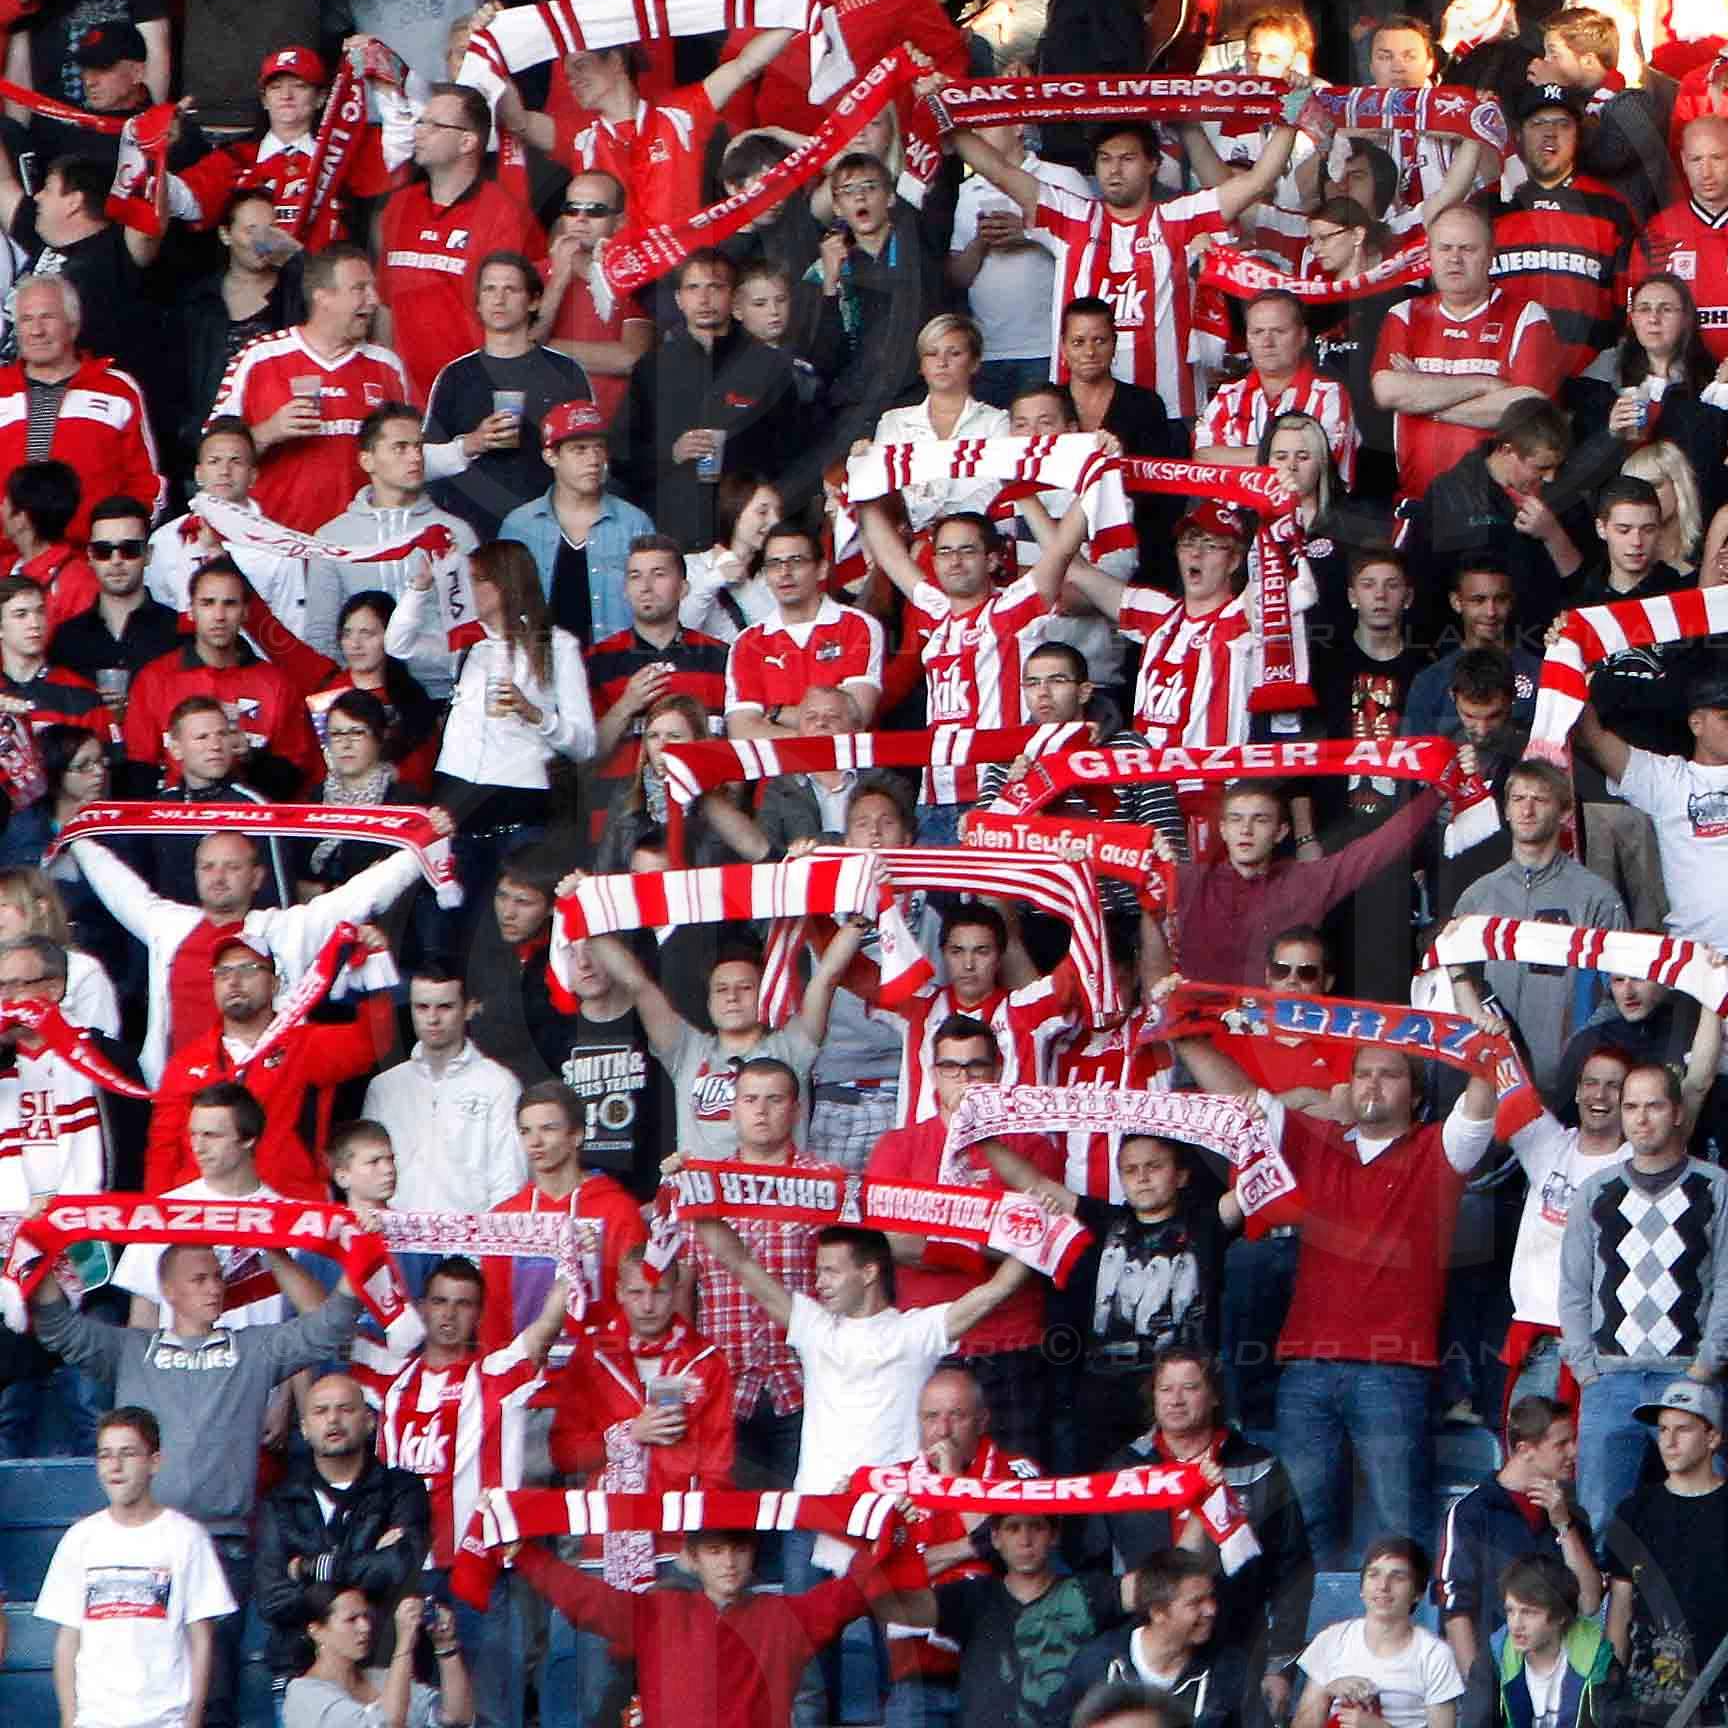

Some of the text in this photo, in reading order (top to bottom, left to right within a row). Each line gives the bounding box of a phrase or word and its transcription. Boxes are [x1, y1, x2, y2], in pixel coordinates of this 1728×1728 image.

[939, 79, 1277, 105] GAK FC LIVERPOOL
[1489, 249, 1602, 276] LIEBHERR
[932, 658, 969, 710] kik
[1139, 666, 1187, 721] kik
[1067, 739, 1433, 780] GRAZER AK
[1015, 826, 1138, 866] Teufel aus
[718, 1172, 839, 1208] GRAZER
[48, 1204, 274, 1235] GRAZER
[398, 1416, 451, 1467] kik
[872, 1467, 1186, 1502] GRAZER AK
